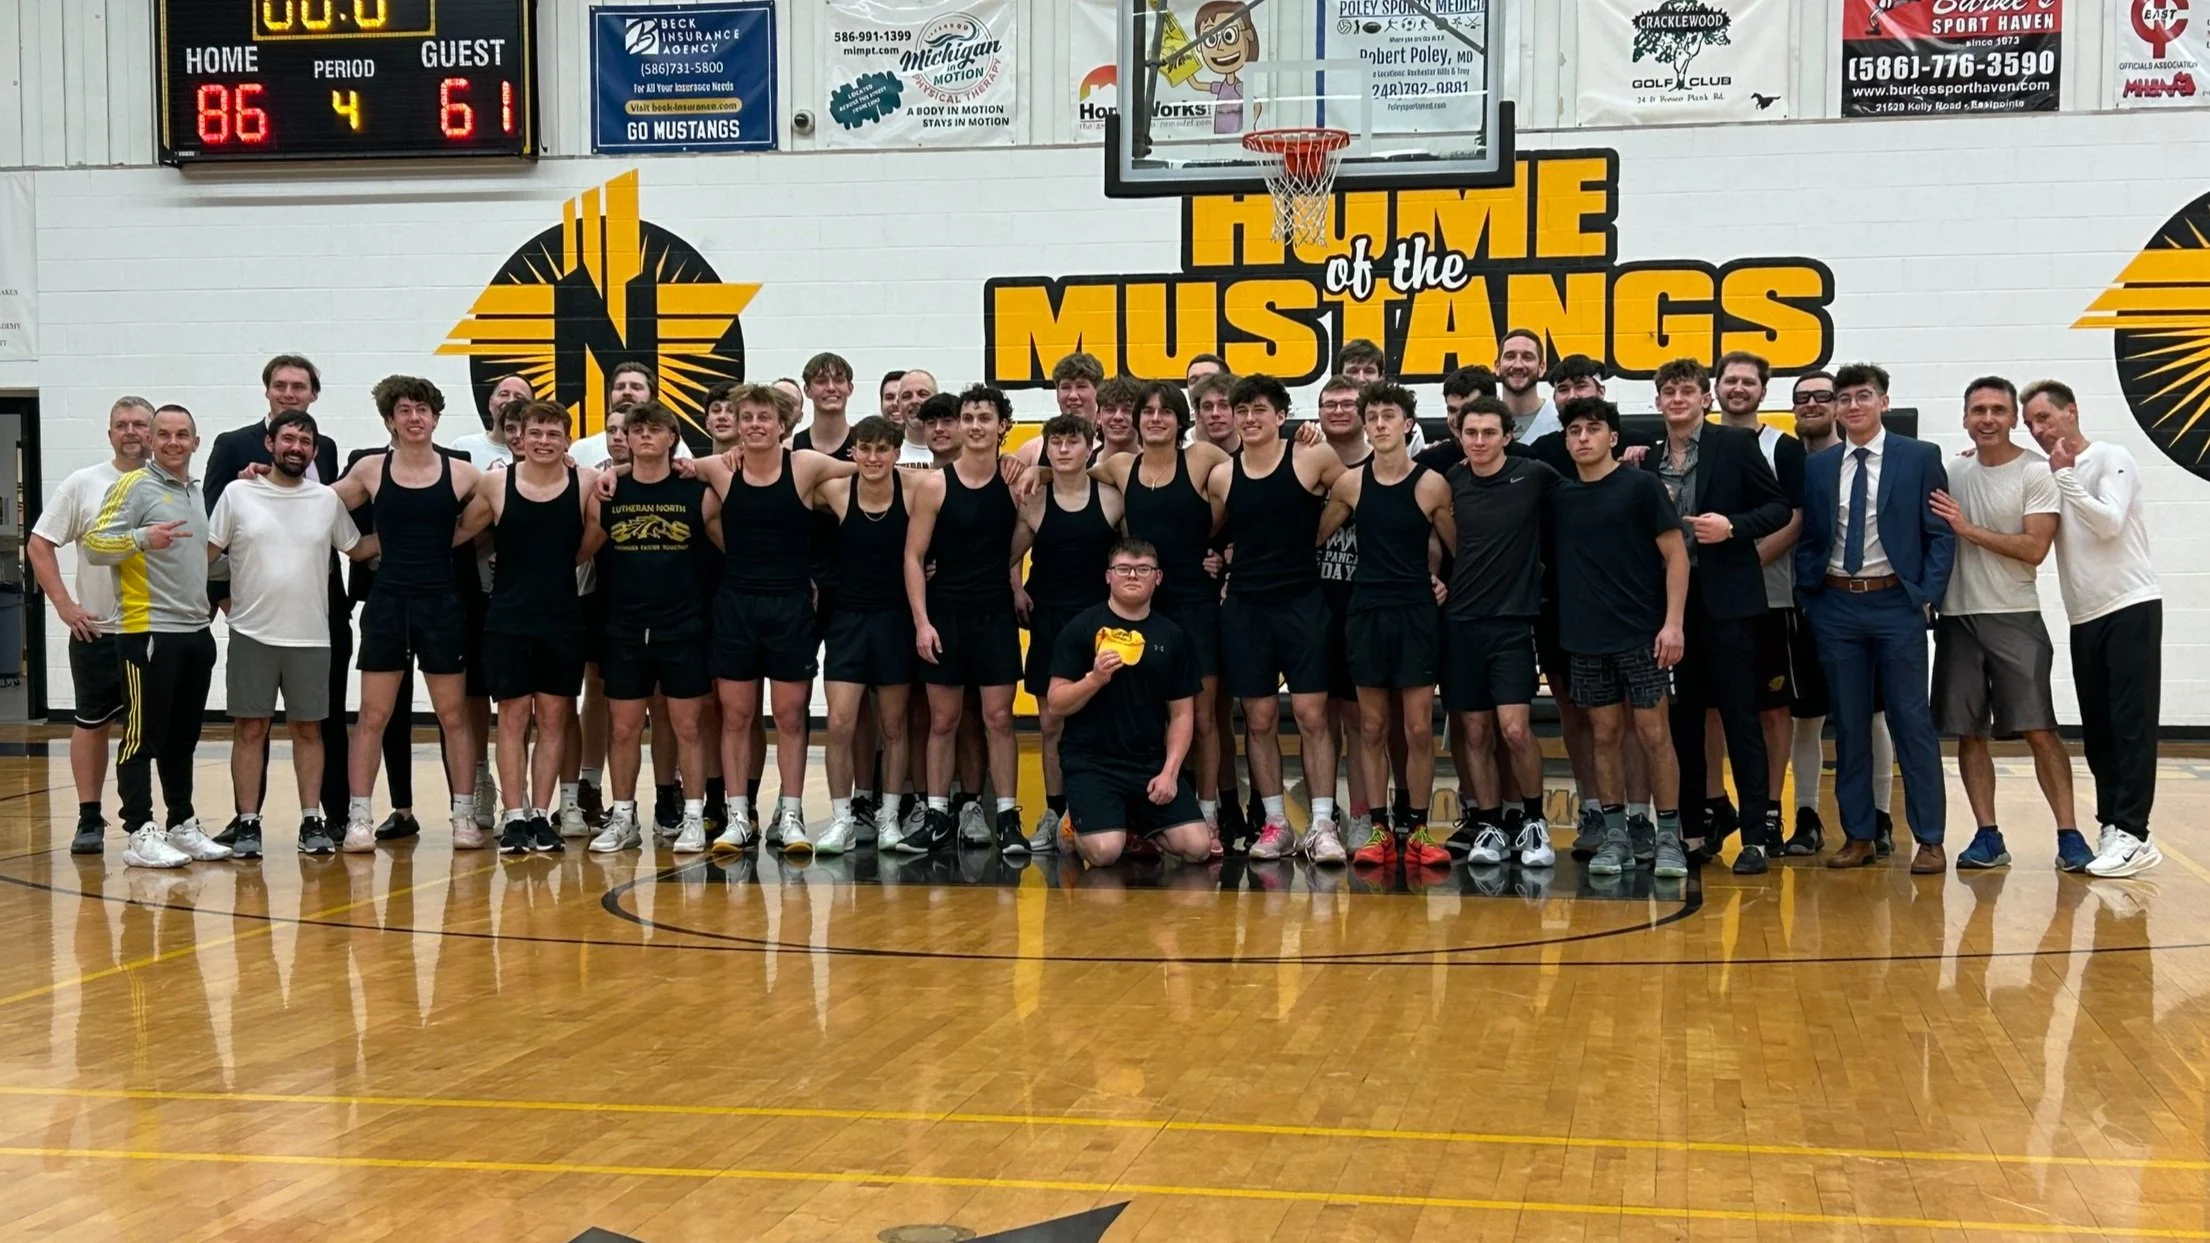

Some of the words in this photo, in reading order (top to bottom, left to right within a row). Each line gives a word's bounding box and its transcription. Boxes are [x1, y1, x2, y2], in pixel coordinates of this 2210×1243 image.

[1340, 0, 1377, 15] POLEY
[2144, 10, 2177, 20] EAST
[661, 18, 697, 29] BECK
[1639, 14, 1724, 29] CRACKLEWOOD
[1932, 17, 1989, 34] SPORT
[1998, 13, 2054, 30] HAVEN
[662, 29, 740, 43] INSURANCE
[1966, 39, 1993, 47] since
[1996, 37, 2020, 46] 1973
[421, 39, 506, 68] GUEST
[663, 43, 718, 55] AGENCY
[843, 46, 900, 57] mimpt.com
[900, 40, 1002, 73] Michigan
[1411, 45, 1452, 66] Poley,
[1457, 51, 1473, 63] MD
[186, 46, 259, 74] HOME
[947, 64, 956, 72] in
[1849, 51, 2055, 81] (586)-776-3590
[313, 59, 375, 79] PERIOD
[641, 61, 724, 78] (586)731-5800
[933, 67, 984, 86] MOTION
[634, 83, 645, 93] For
[647, 83, 656, 93] All
[657, 83, 673, 93] Your
[675, 82, 711, 92] Insurance
[712, 81, 734, 92] Needs
[912, 73, 961, 104] PHYSICAL
[966, 58, 1002, 102] THERAPY
[1632, 79, 1673, 89] GOLF
[1689, 77, 1732, 86] CLUB
[1852, 81, 2050, 97] www.burkessporthaven.com
[196, 83, 268, 144] 86
[331, 89, 361, 131] 4
[630, 103, 650, 113] Visit
[652, 102, 738, 112] beck-insurance.com
[907, 107, 914, 116] A
[917, 106, 945, 116] BODY
[948, 106, 959, 116] IN
[962, 105, 1004, 115] MOTION
[1908, 102, 1932, 112] Kelly
[1935, 101, 1961, 110] Road
[628, 121, 648, 141] GO
[654, 119, 741, 140] MUSTANGS
[923, 118, 954, 128] STAYS
[955, 118, 965, 127] IN
[968, 117, 1010, 127] MOTION
[1192, 158, 1607, 266] HOME
[1326, 239, 1374, 299] of
[1393, 238, 1468, 291] the
[994, 265, 1831, 384] MUSTANGS
[612, 504, 654, 513] LUTHERAN
[656, 504, 687, 512] NORTH
[1320, 561, 1357, 581] DAY
